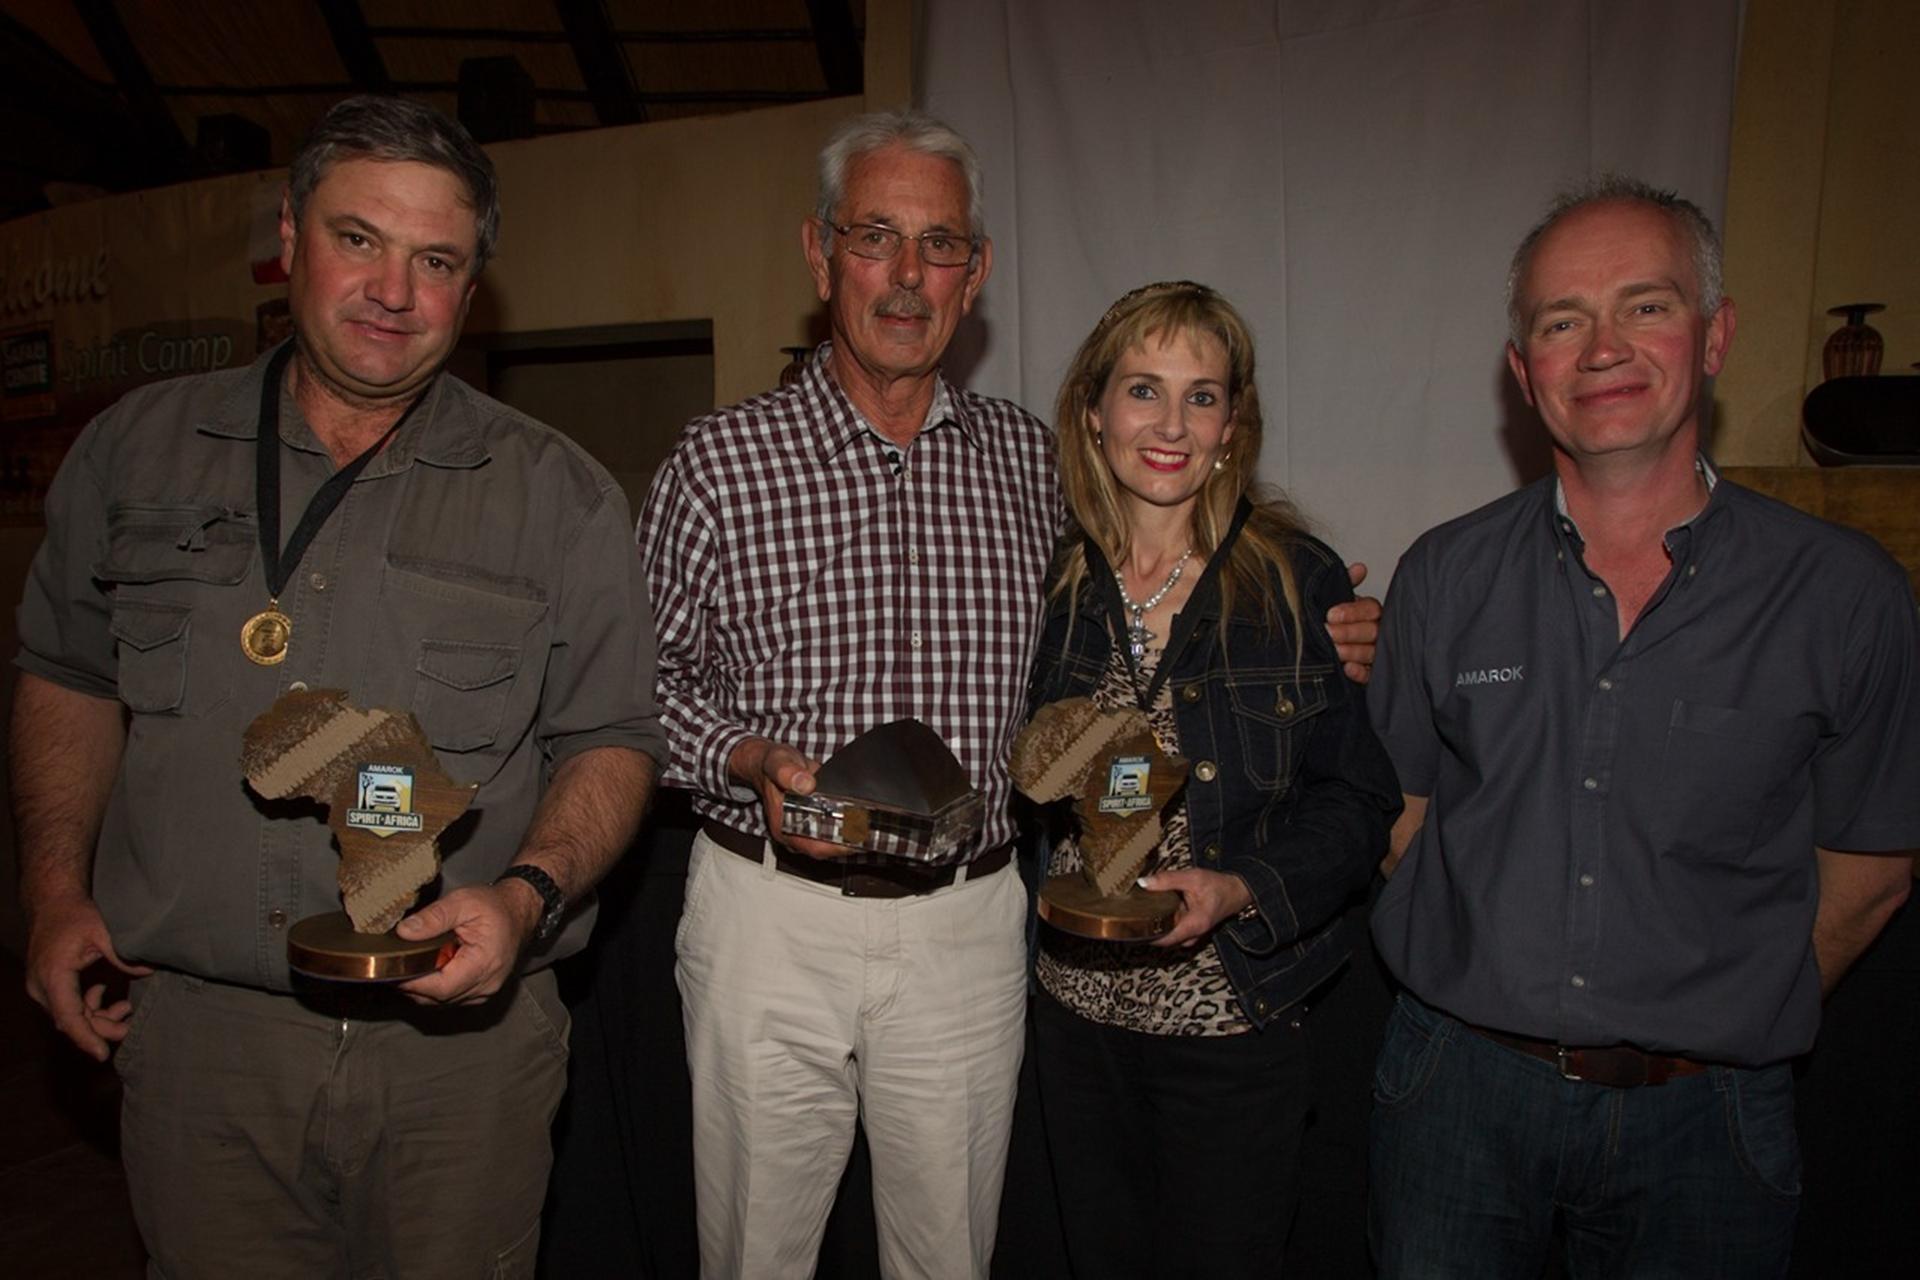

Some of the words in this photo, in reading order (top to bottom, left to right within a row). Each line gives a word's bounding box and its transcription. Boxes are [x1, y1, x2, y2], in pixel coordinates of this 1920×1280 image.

[61, 335, 129, 391] Spirit
[137, 331, 232, 373] Camp
[1455, 665, 1524, 687] AMAROK
[367, 764, 404, 775] AMAROK
[349, 811, 381, 825] SPIRIT
[383, 813, 419, 827] AFRICA
